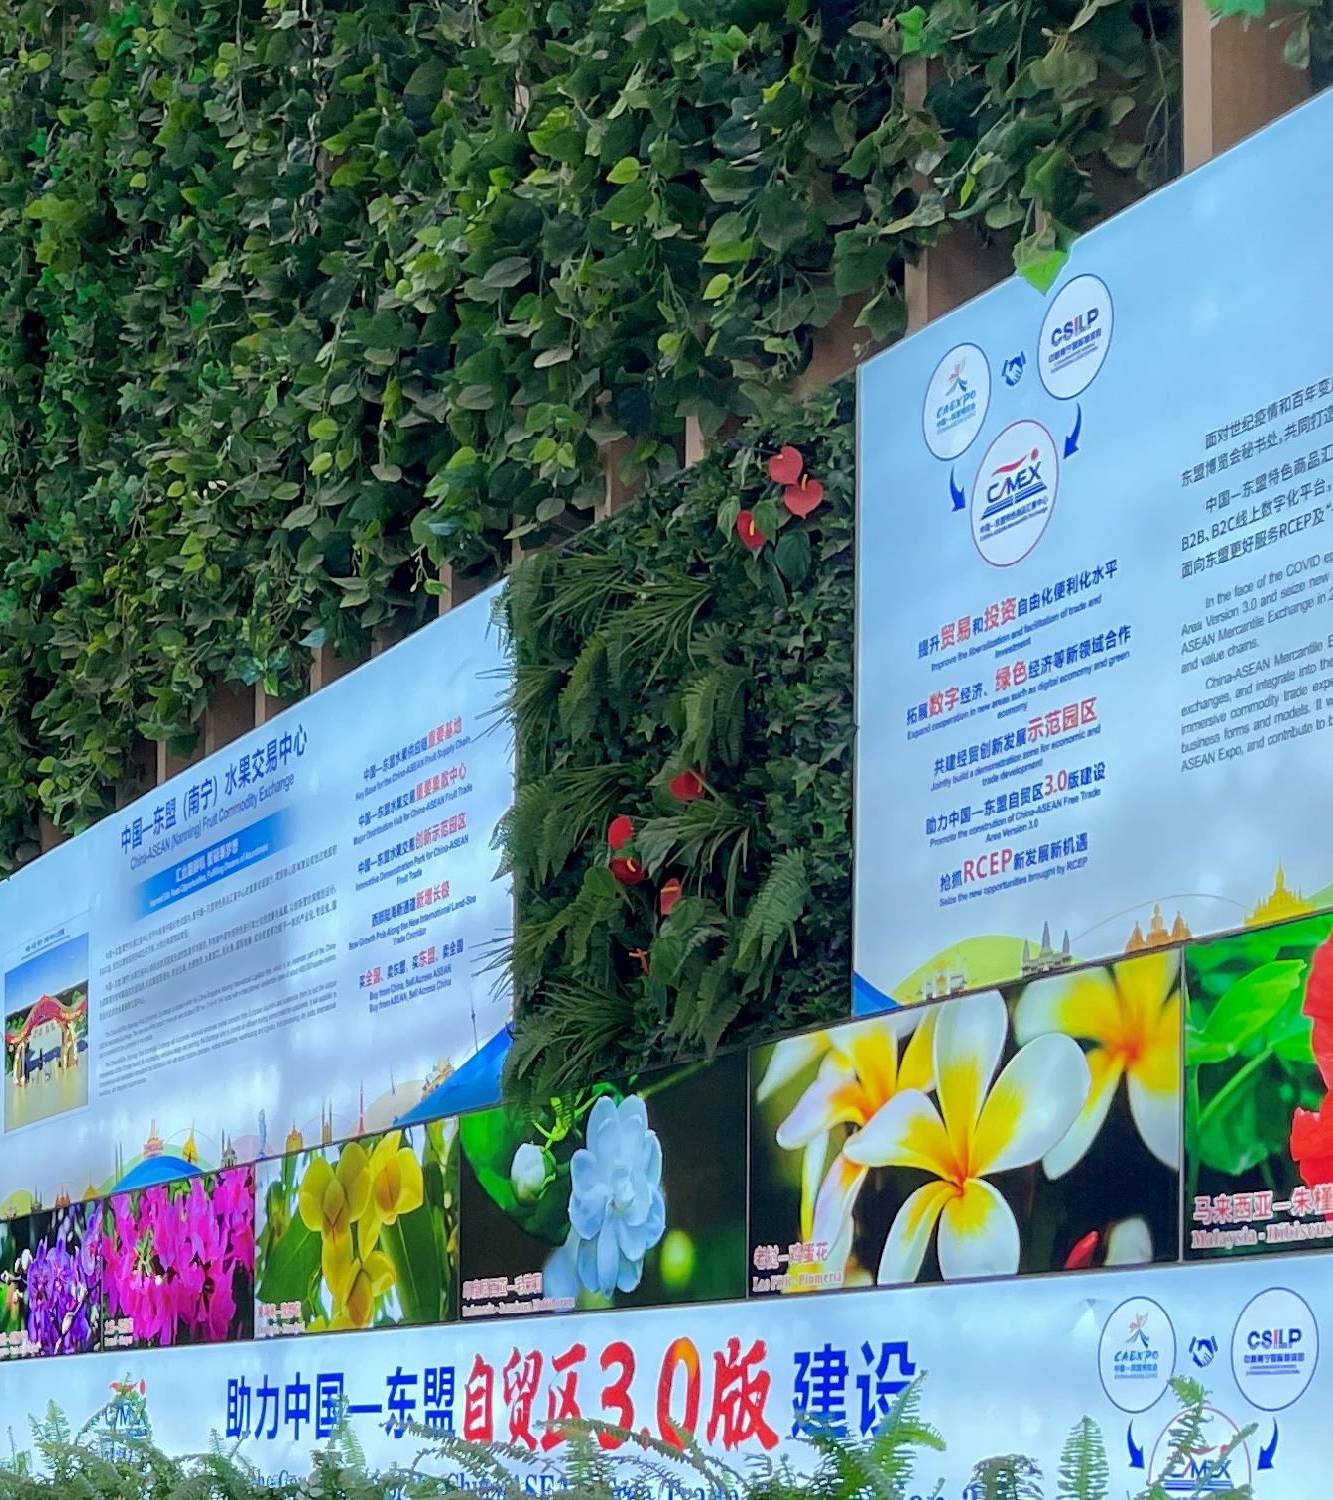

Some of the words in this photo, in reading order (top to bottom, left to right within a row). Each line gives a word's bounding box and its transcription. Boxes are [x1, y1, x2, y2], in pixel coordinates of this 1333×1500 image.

[1051, 307, 1099, 347] CSILP
[936, 389, 976, 419] CAEXPO
[1205, 376, 1333, 450] 面对世纪疫情和百年变
[1205, 596, 1215, 609] In
[1285, 554, 1320, 578] COVID
[917, 558, 1118, 659] 提升贸易和投资自由化便利化水平
[933, 696, 1097, 777] 共建经贸创新发展示范园区
[1191, 1226, 1257, 1249] Malaysia
[1113, 1350, 1160, 1363] CAEXPO
[1247, 1328, 1303, 1350] CSILP
